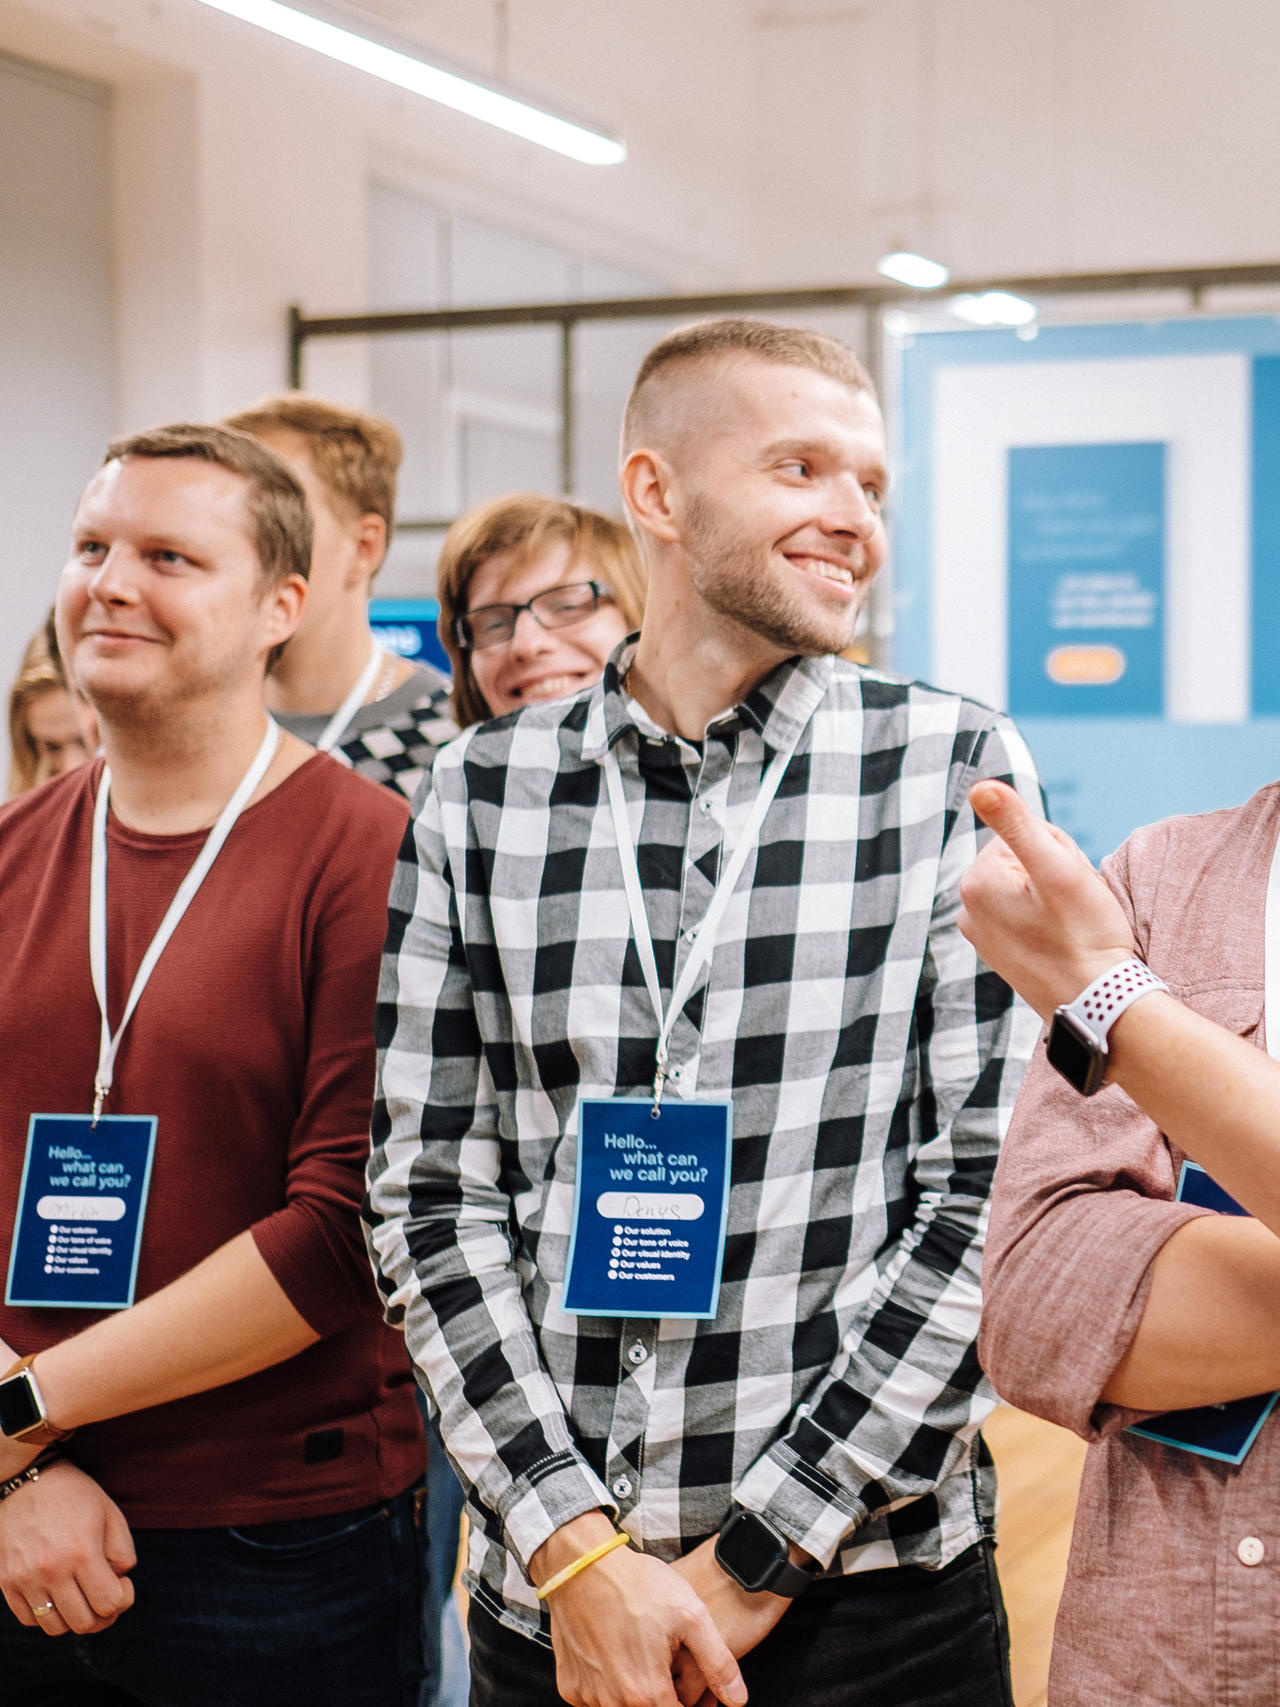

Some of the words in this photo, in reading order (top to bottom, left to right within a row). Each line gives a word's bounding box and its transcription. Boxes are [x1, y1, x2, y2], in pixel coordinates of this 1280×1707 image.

[604, 1132, 657, 1150] Hello...
[48, 1145, 92, 1160] Hello...
[623, 1150, 664, 1166] what
[667, 1153, 697, 1167] can
[62, 1161, 95, 1173] what
[99, 1162, 124, 1174] can
[50, 1176, 69, 1187] we
[72, 1174, 96, 1187] call
[99, 1175, 132, 1191] you?
[610, 1168, 633, 1181] we
[637, 1167, 666, 1182] call
[669, 1167, 708, 1186] you?
[624, 1226, 640, 1235] Our
[623, 1237, 638, 1246] Our
[639, 1239, 657, 1247] tone
[658, 1238, 668, 1247] of
[668, 1240, 689, 1248] voice
[622, 1249, 637, 1258] Our
[638, 1250, 660, 1258] visual
[660, 1250, 691, 1260] identity
[620, 1260, 636, 1269] Our
[636, 1261, 661, 1269] values
[618, 1271, 634, 1280] Our
[634, 1272, 675, 1281] customers
